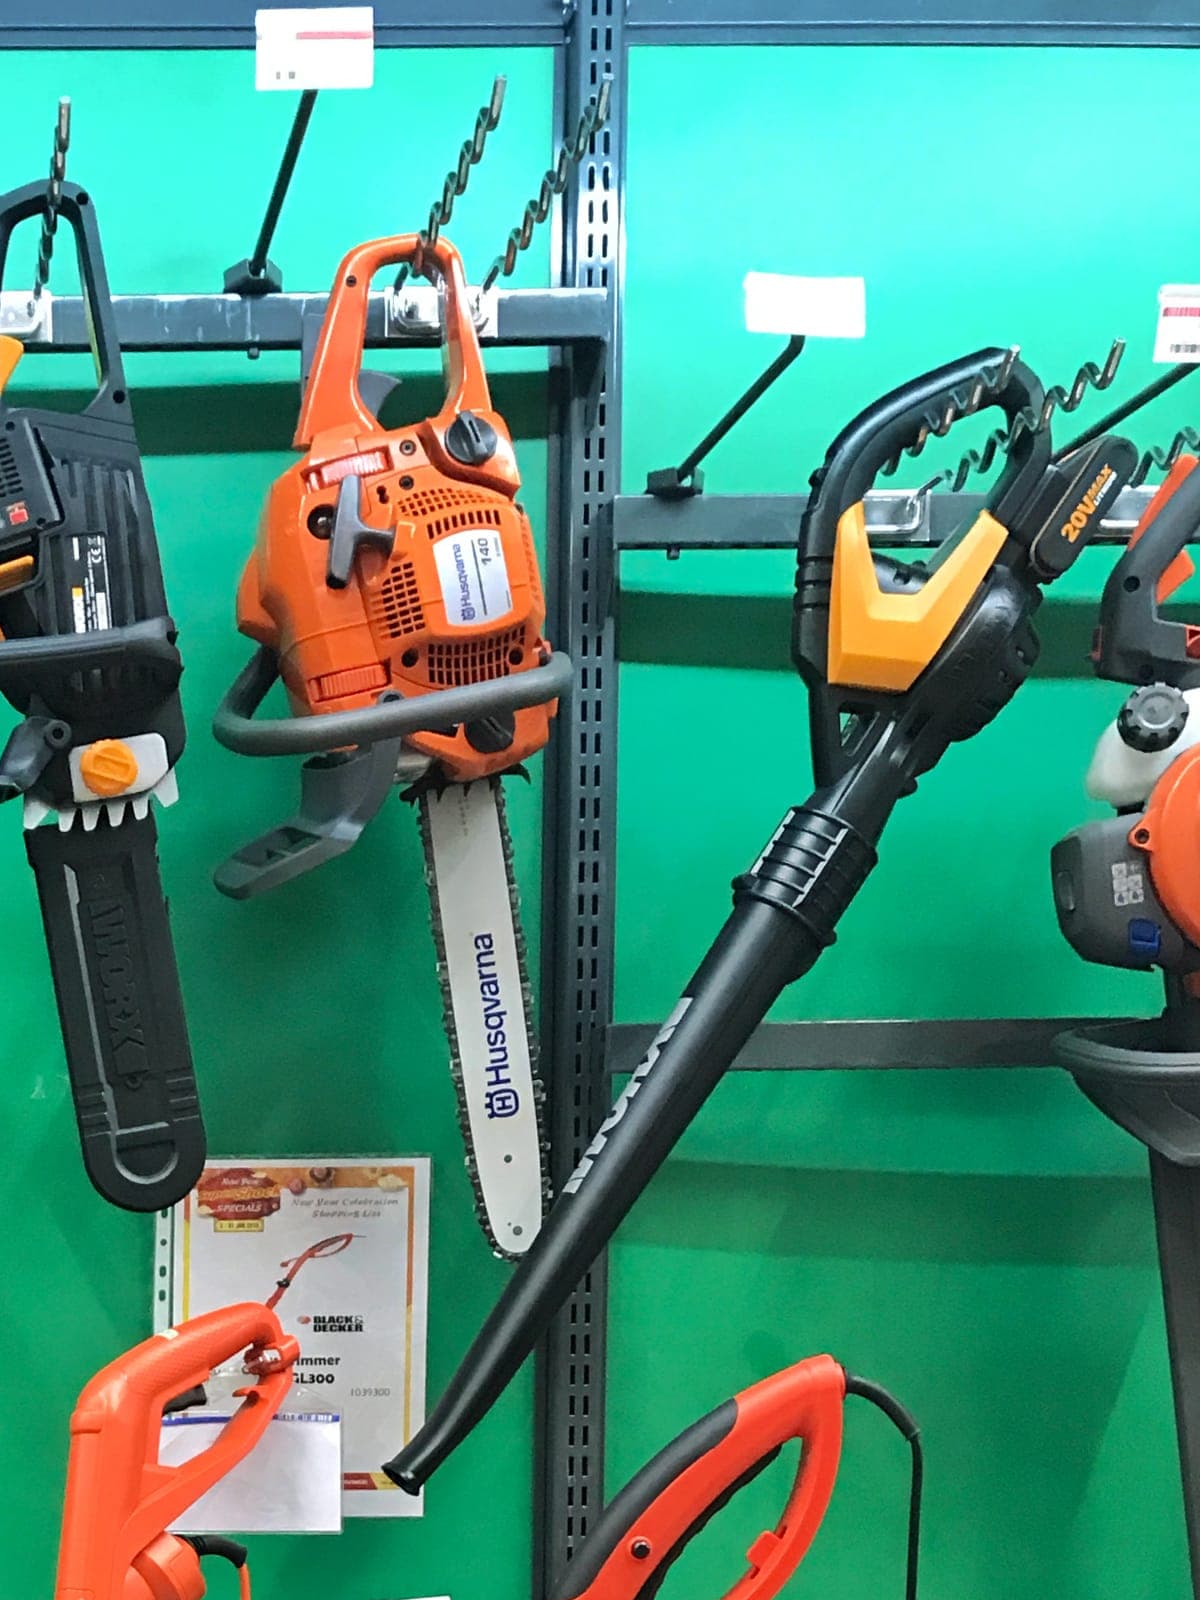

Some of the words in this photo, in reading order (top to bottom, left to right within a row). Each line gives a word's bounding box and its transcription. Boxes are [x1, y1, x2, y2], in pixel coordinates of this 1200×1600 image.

[477, 537, 492, 566] 140
[452, 543, 472, 607] Husqvarna
[474, 932, 512, 1087] Husqvarna
[216, 1203, 263, 1213] SPECIALS
[350, 1387, 391, 1397] 1039300
